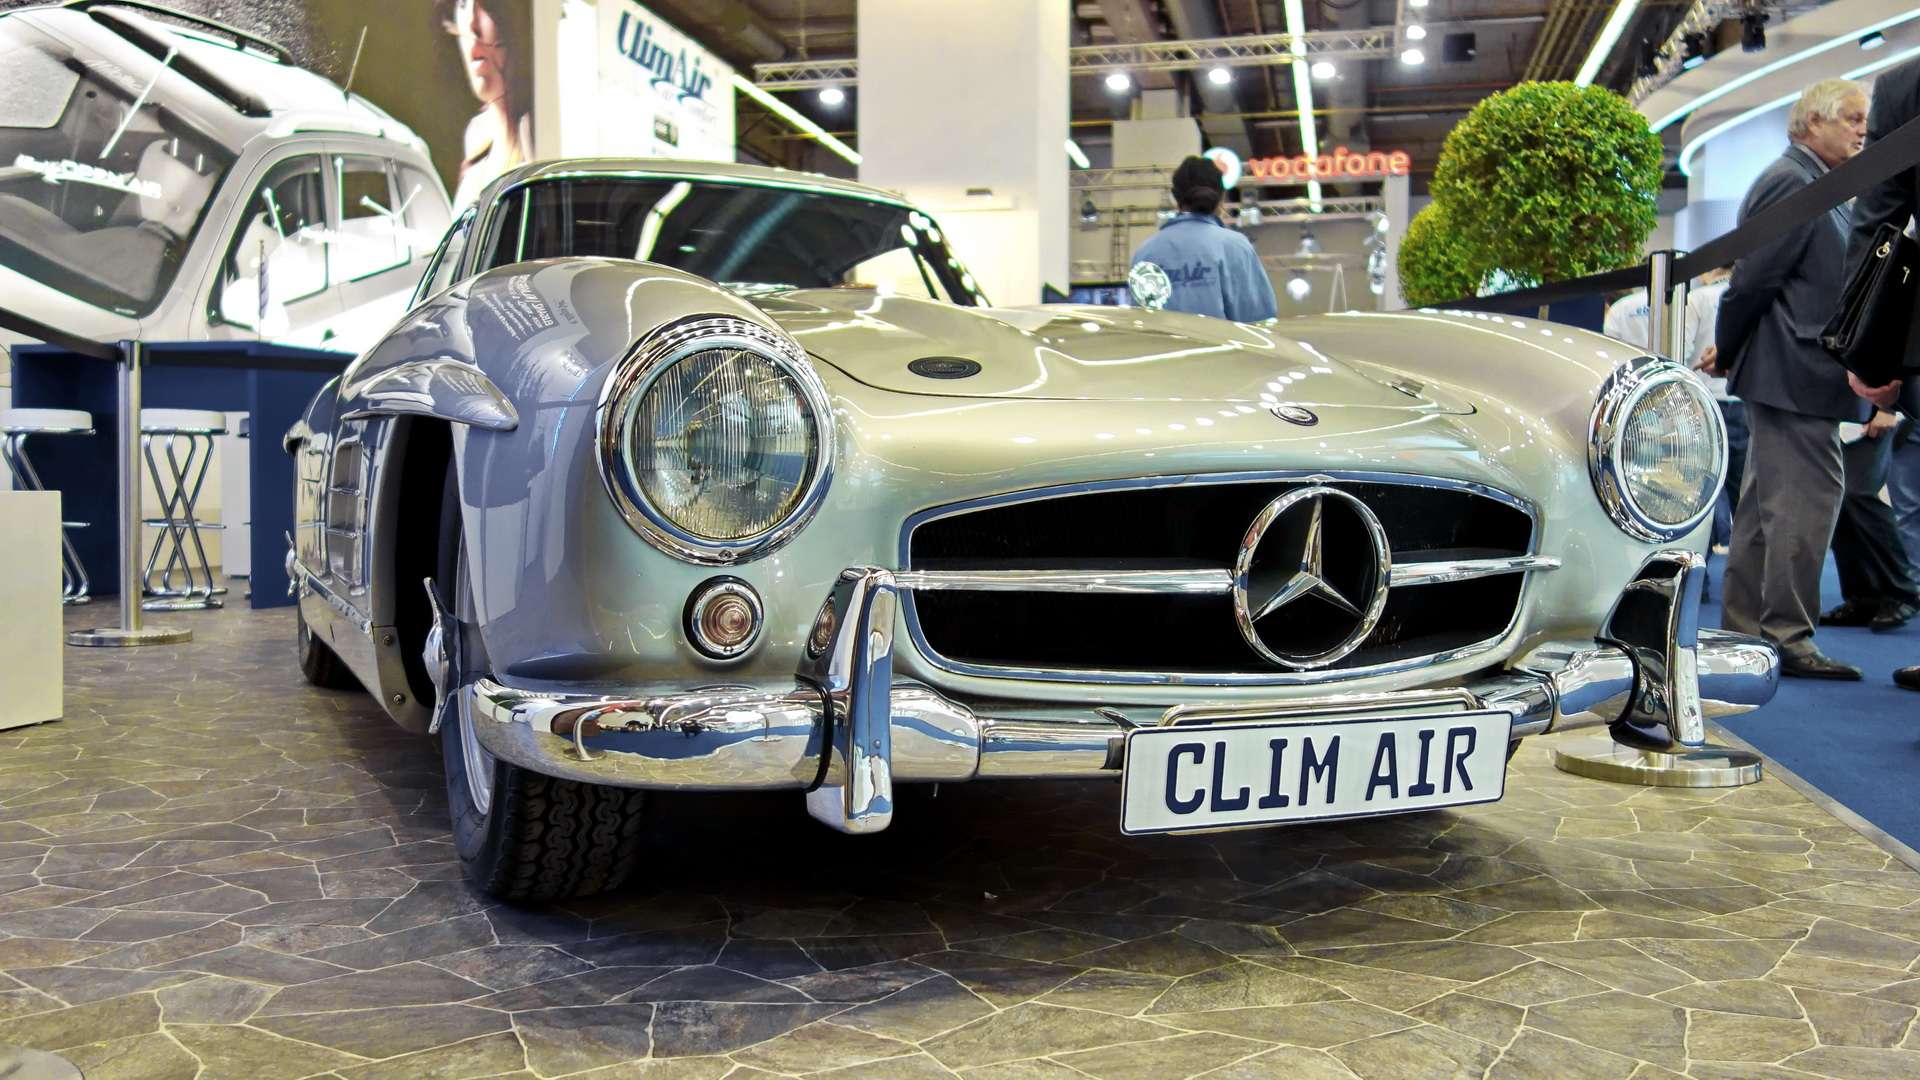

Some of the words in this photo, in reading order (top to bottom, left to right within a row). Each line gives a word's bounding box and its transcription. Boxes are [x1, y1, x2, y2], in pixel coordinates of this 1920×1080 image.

[617, 10, 711, 100] ClimAir
[1249, 145, 1411, 179] vodafone
[1165, 735, 1340, 814] CLIM
[1366, 727, 1476, 801] AIR
